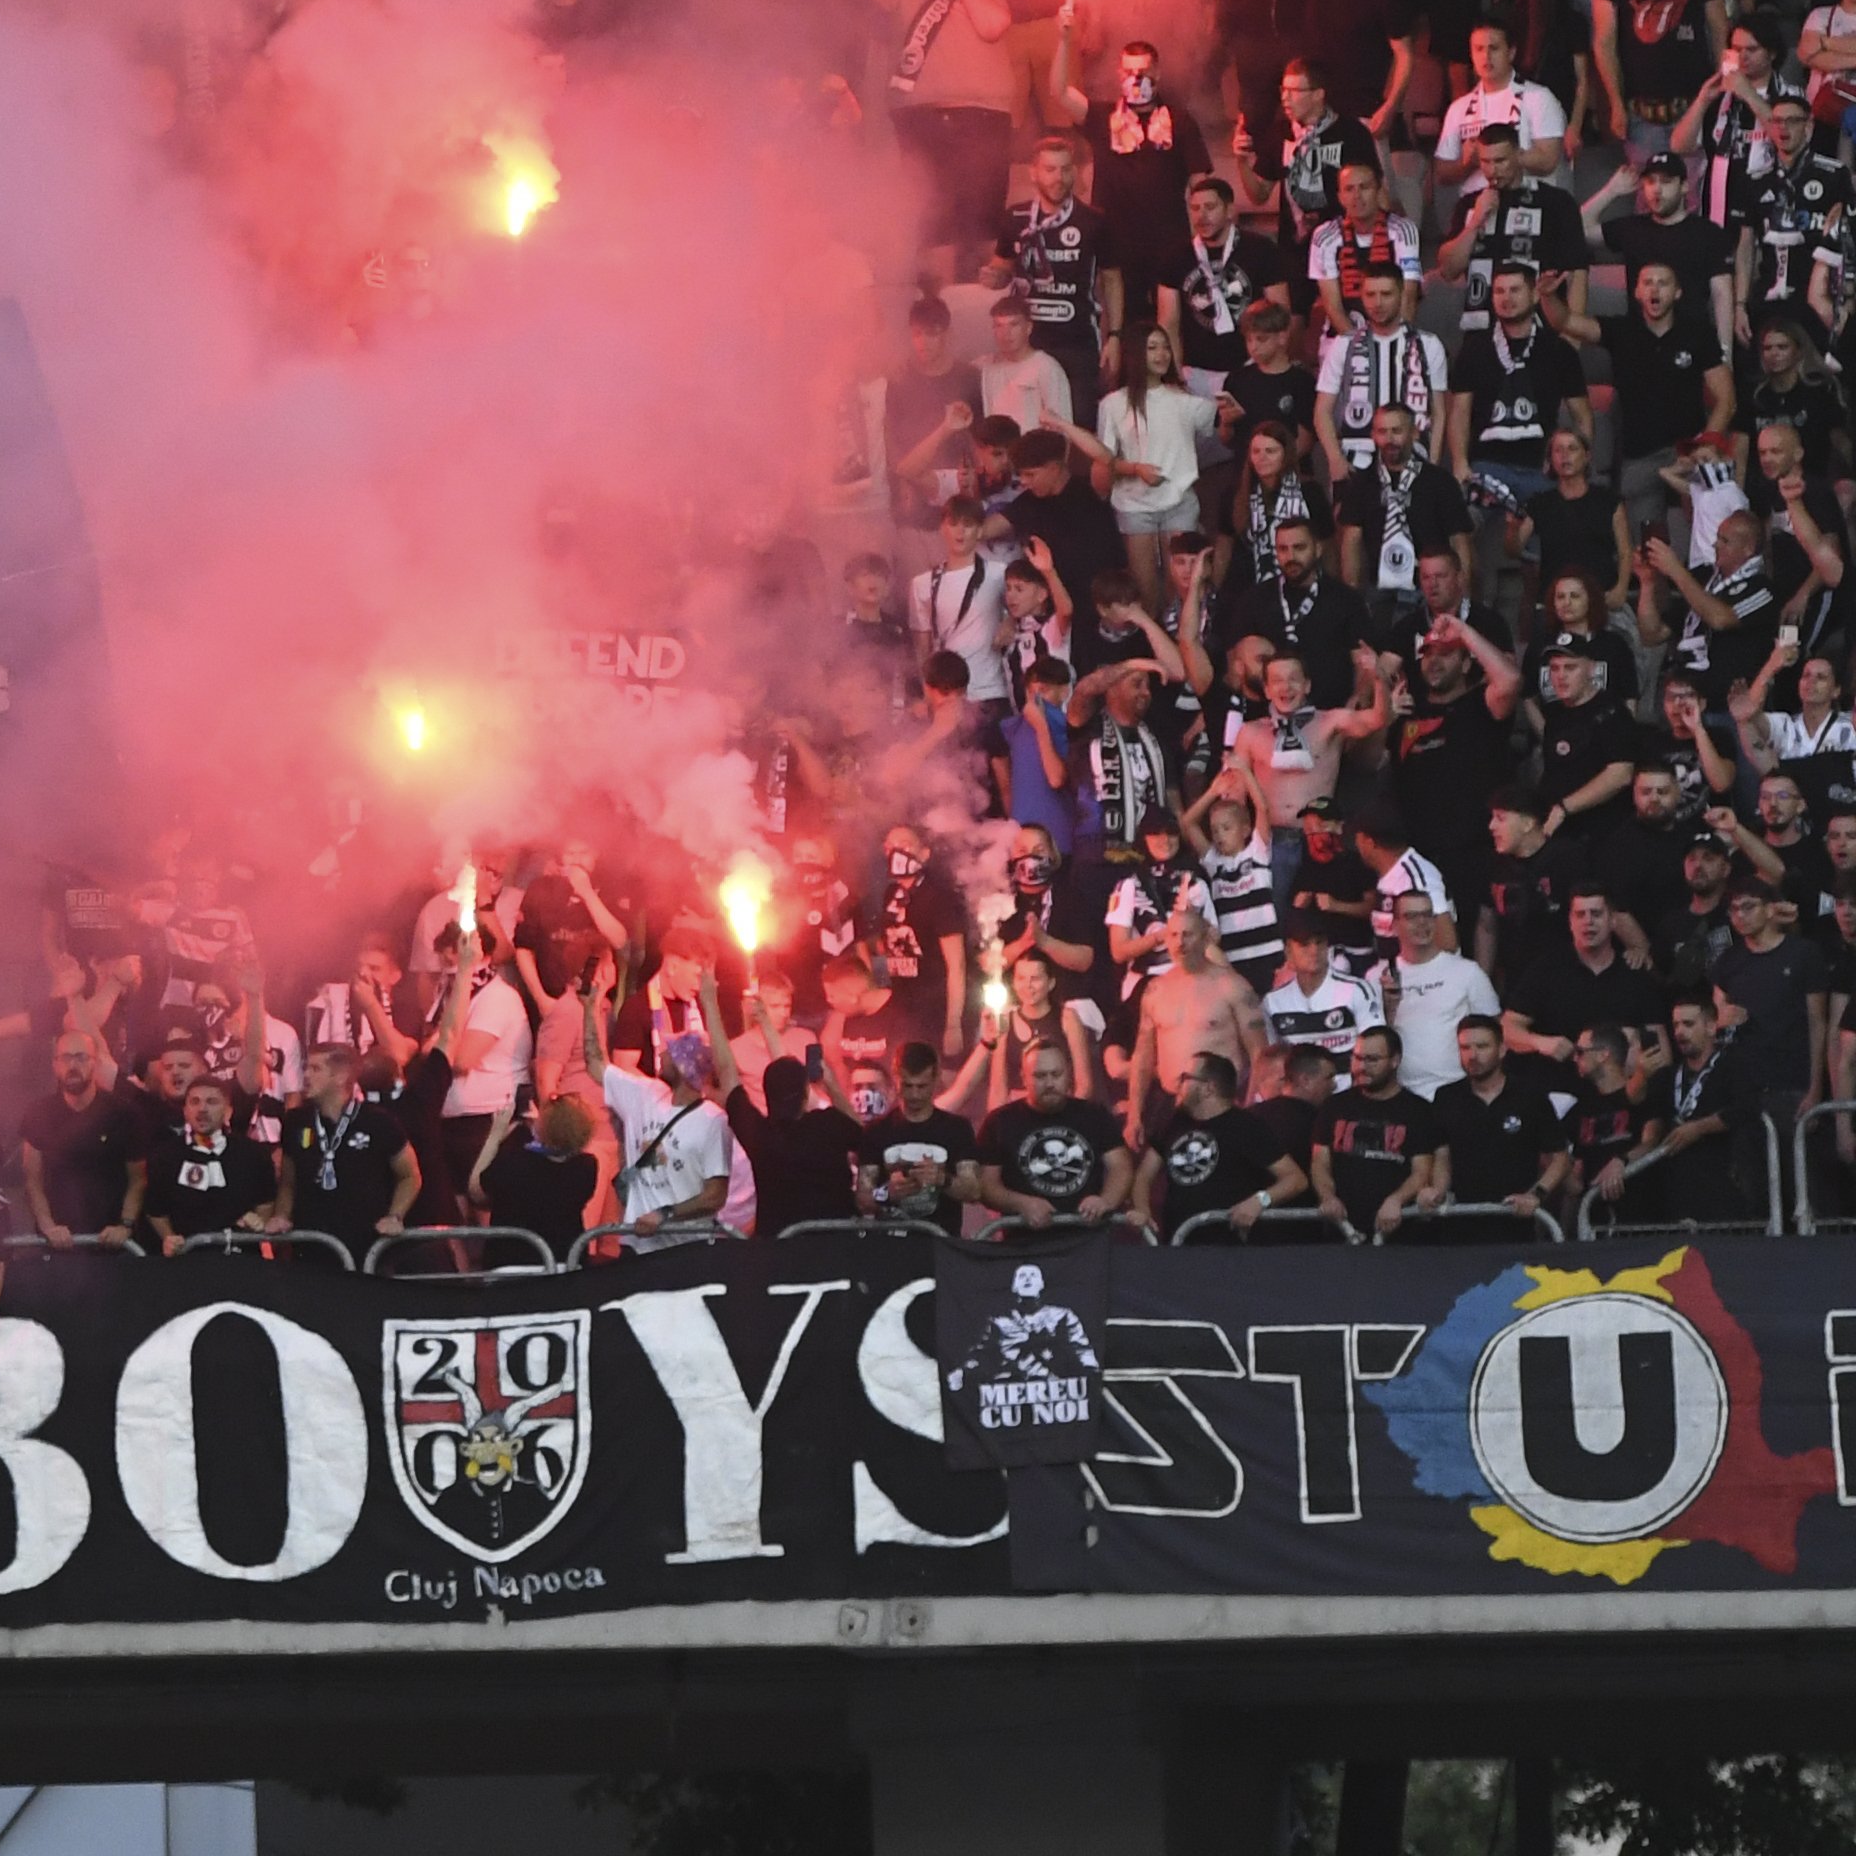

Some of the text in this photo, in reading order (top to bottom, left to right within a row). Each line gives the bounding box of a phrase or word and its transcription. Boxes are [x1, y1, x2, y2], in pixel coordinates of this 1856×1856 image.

[495, 629, 687, 679] DFEND
[978, 1376, 1088, 1406] MEREU
[980, 1399, 1090, 1429] CU NOI
[384, 1565, 608, 1610] Cluj Napoca
